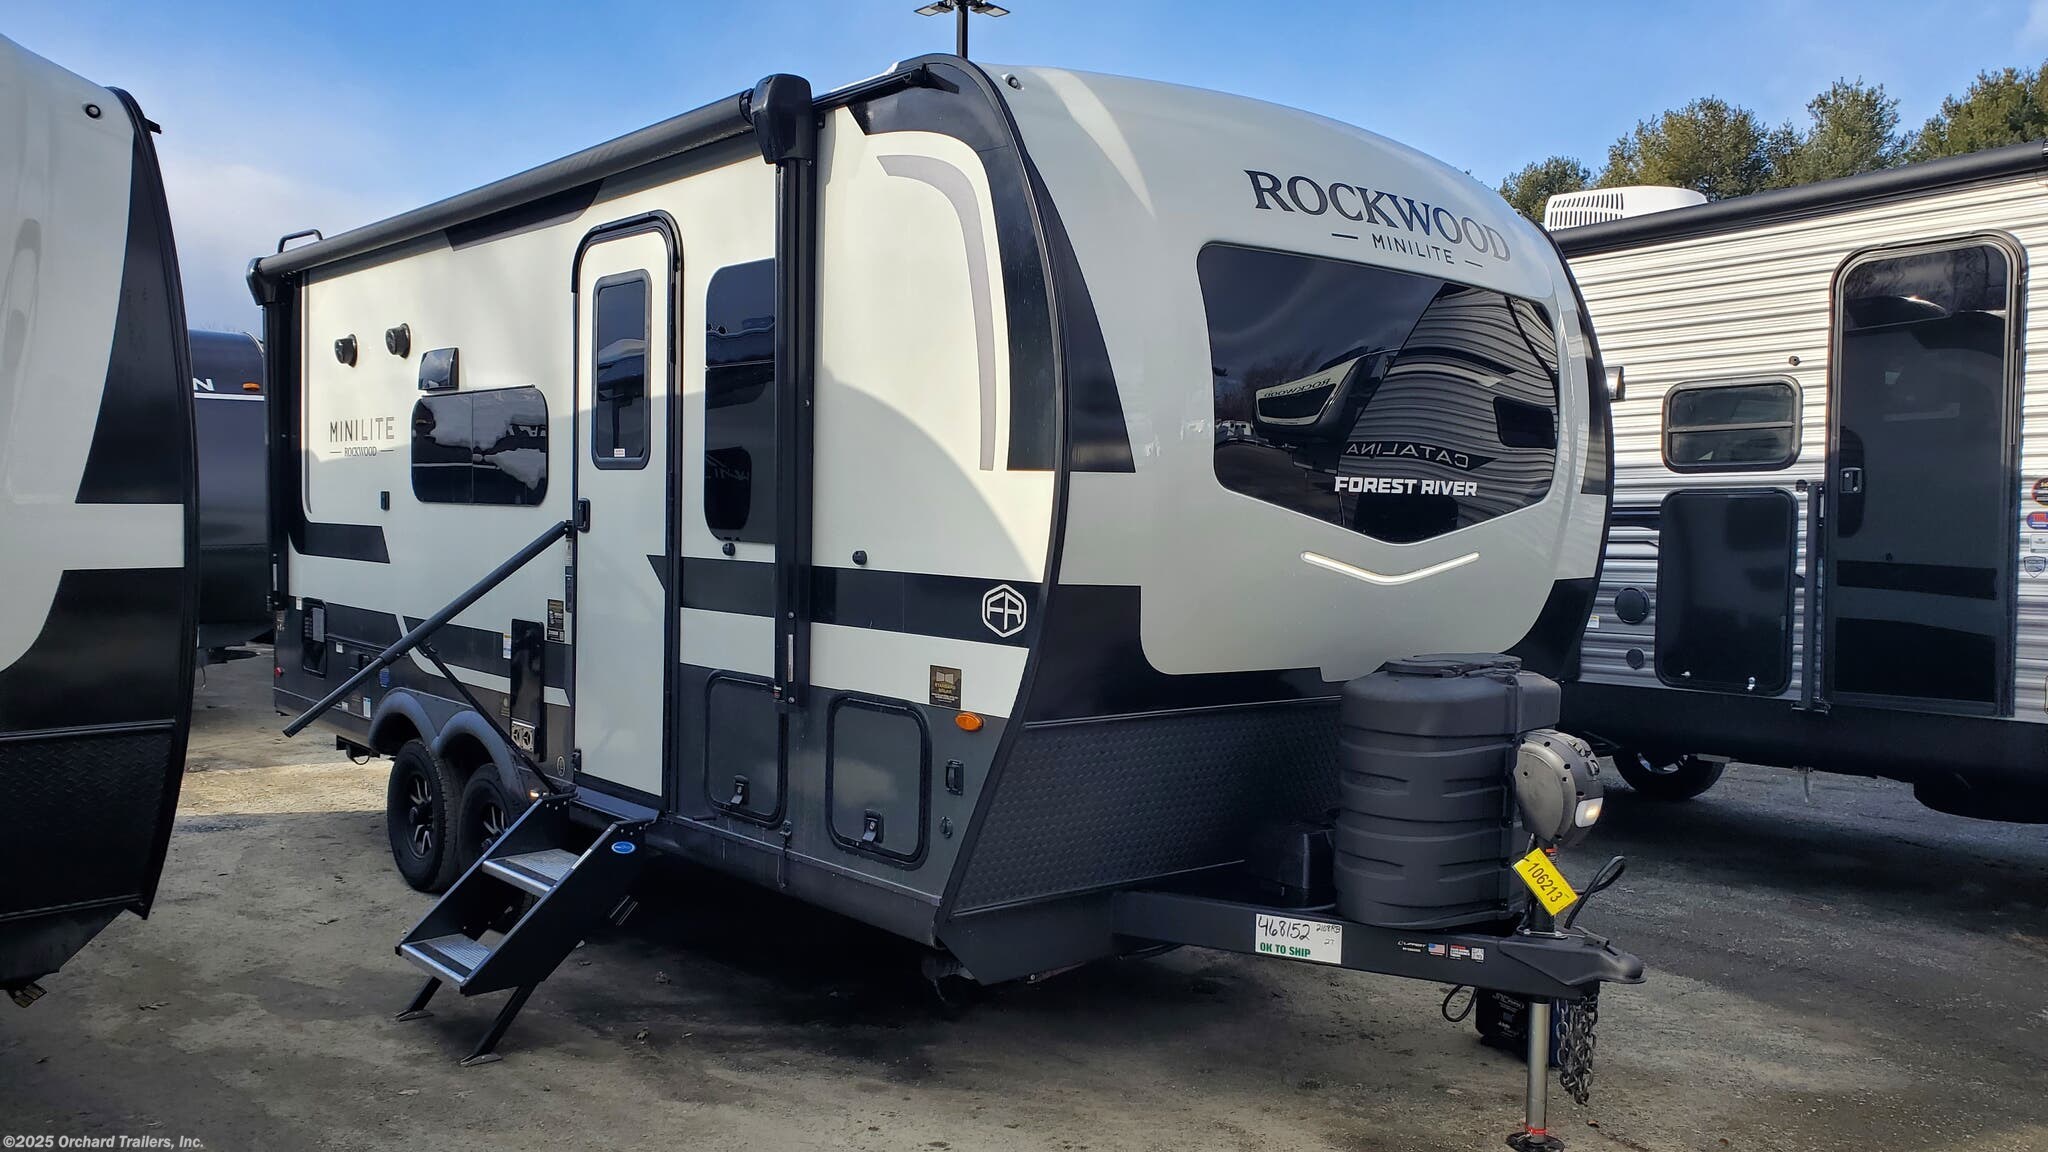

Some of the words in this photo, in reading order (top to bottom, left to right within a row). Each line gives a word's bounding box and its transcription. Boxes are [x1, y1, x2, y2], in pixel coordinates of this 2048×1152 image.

[1244, 169, 1511, 262] ROCKWOOD
[1371, 233, 1455, 265] MINILITE
[329, 416, 395, 443] MINILITE
[344, 446, 378, 457] ROCKWOOD
[1334, 476, 1418, 495] FOREST
[1420, 479, 1478, 497] RIVER
[1527, 862, 1564, 903] 106213
[1257, 915, 1310, 941] 468152
[1260, 942, 1273, 952] OK
[1275, 944, 1287, 954] TO
[1289, 946, 1311, 957] SHIP
